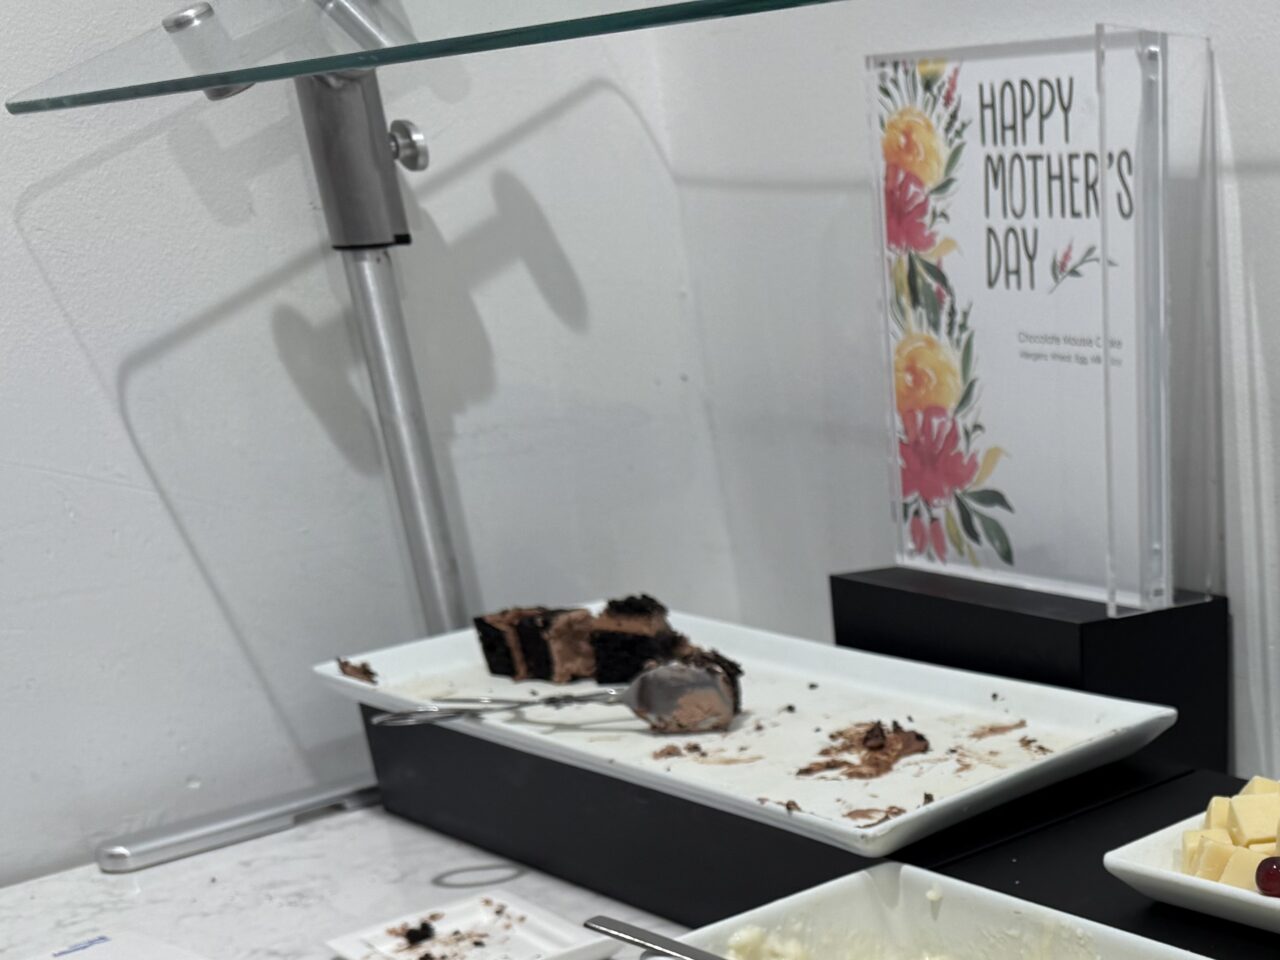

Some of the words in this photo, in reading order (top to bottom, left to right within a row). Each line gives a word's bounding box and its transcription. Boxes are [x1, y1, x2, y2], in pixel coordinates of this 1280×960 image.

[979, 77, 1074, 147] HAPPY
[984, 150, 1134, 220] MOTHER'S
[986, 226, 1038, 290] DAY
